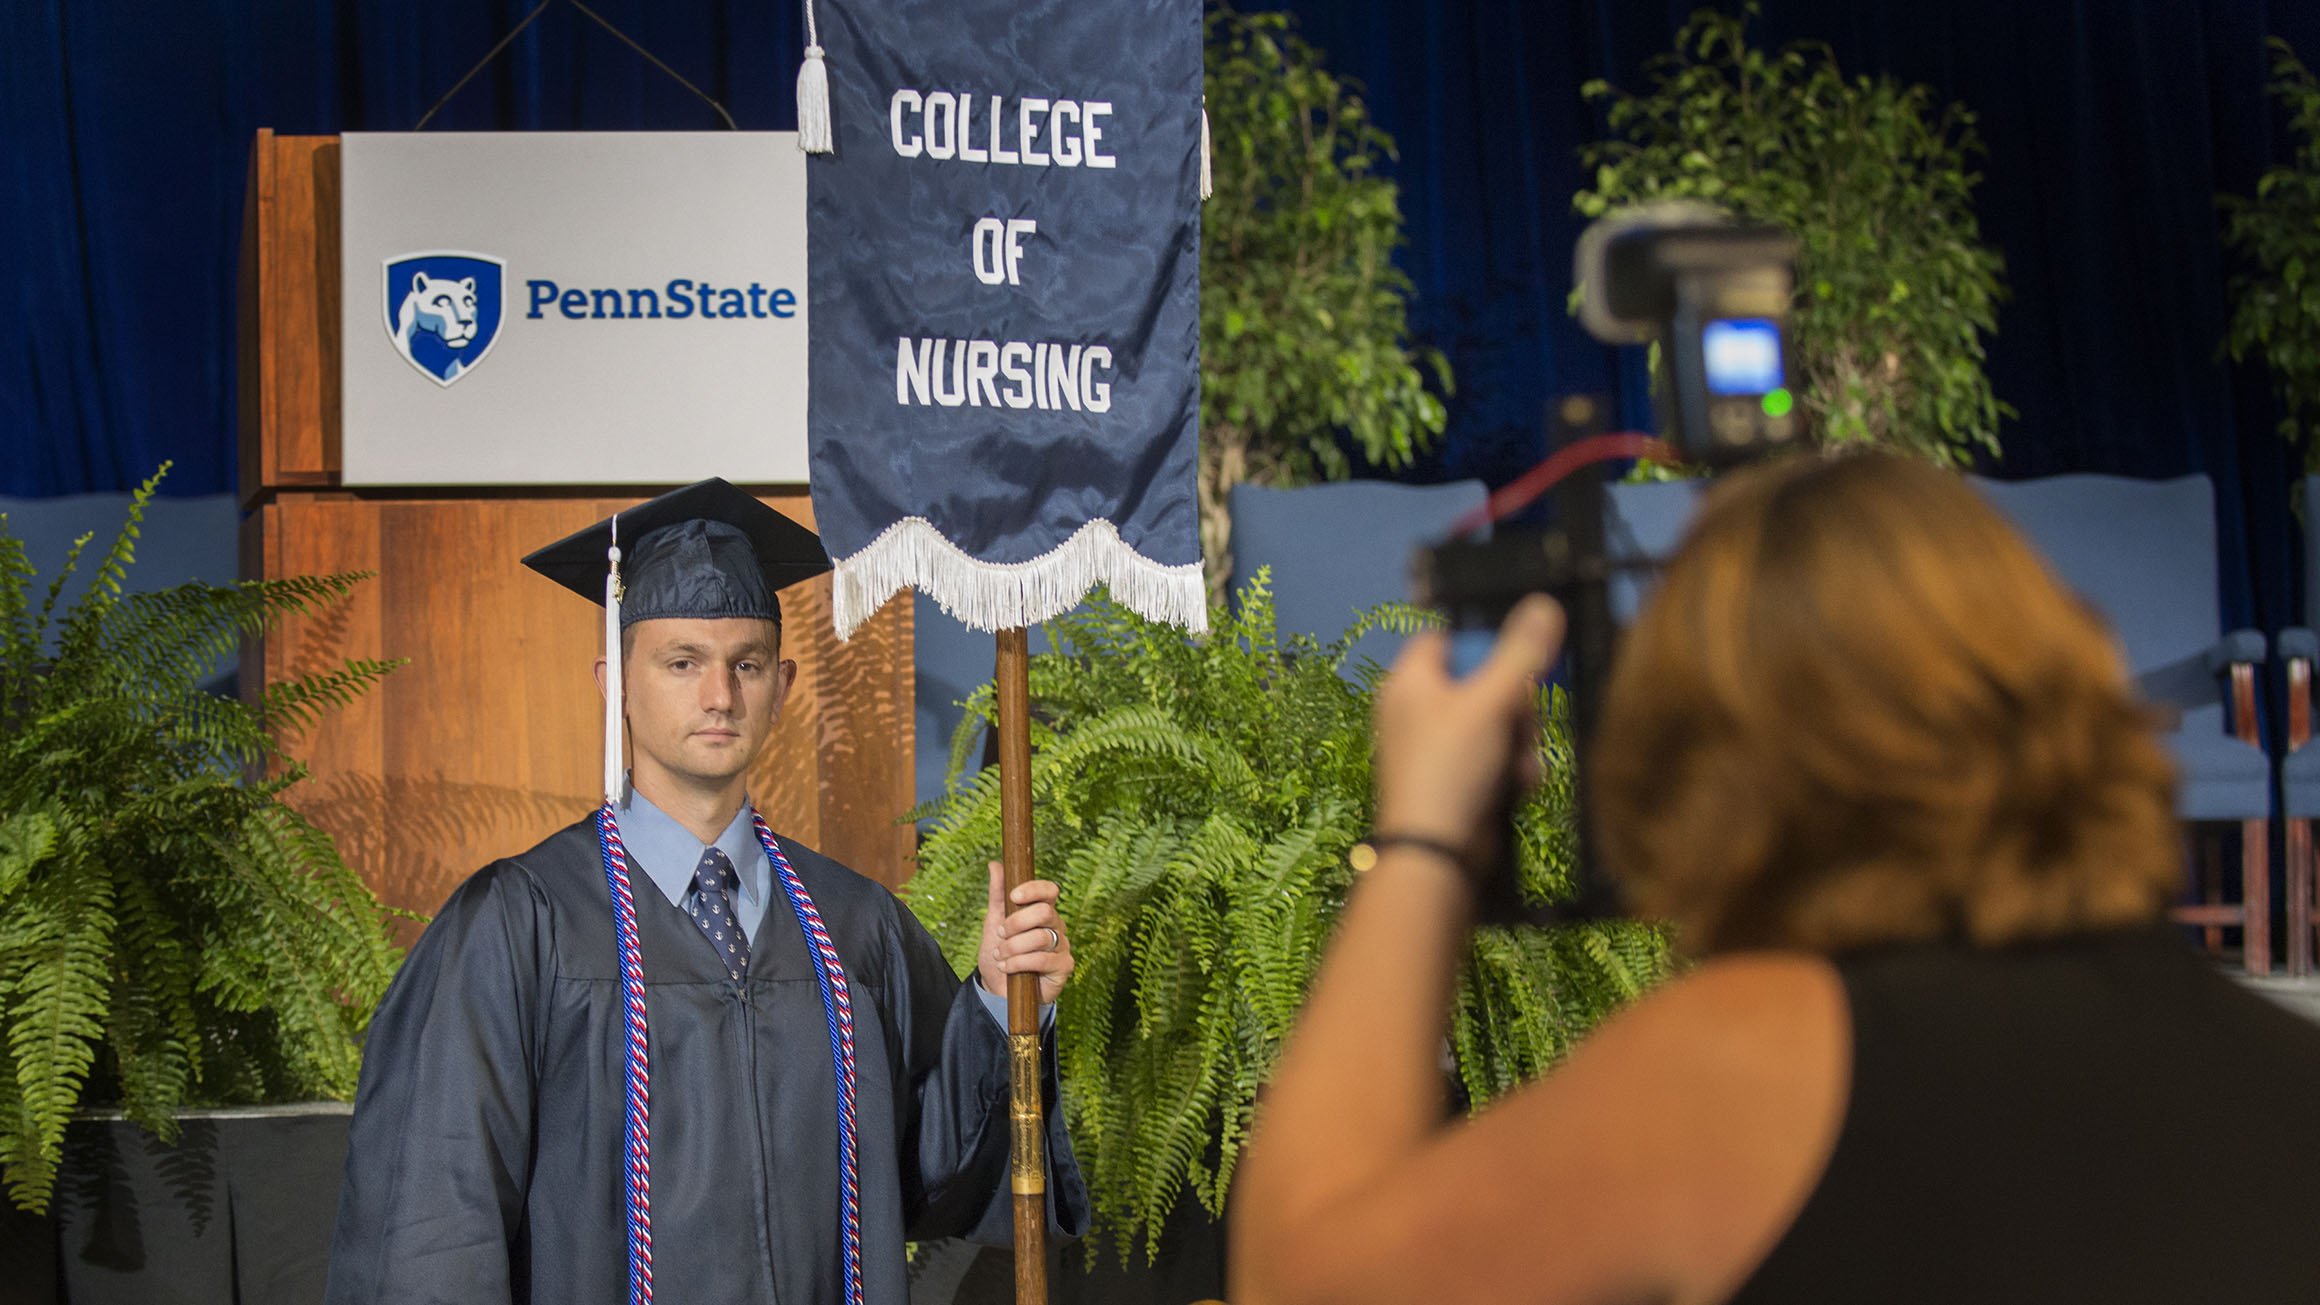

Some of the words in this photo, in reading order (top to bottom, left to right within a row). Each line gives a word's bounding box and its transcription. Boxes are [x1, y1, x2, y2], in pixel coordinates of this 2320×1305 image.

[890, 89, 1116, 168] COLLEGE
[972, 217, 1036, 286] OF
[526, 279, 796, 319] PennState
[896, 336, 1112, 413] NURSING
